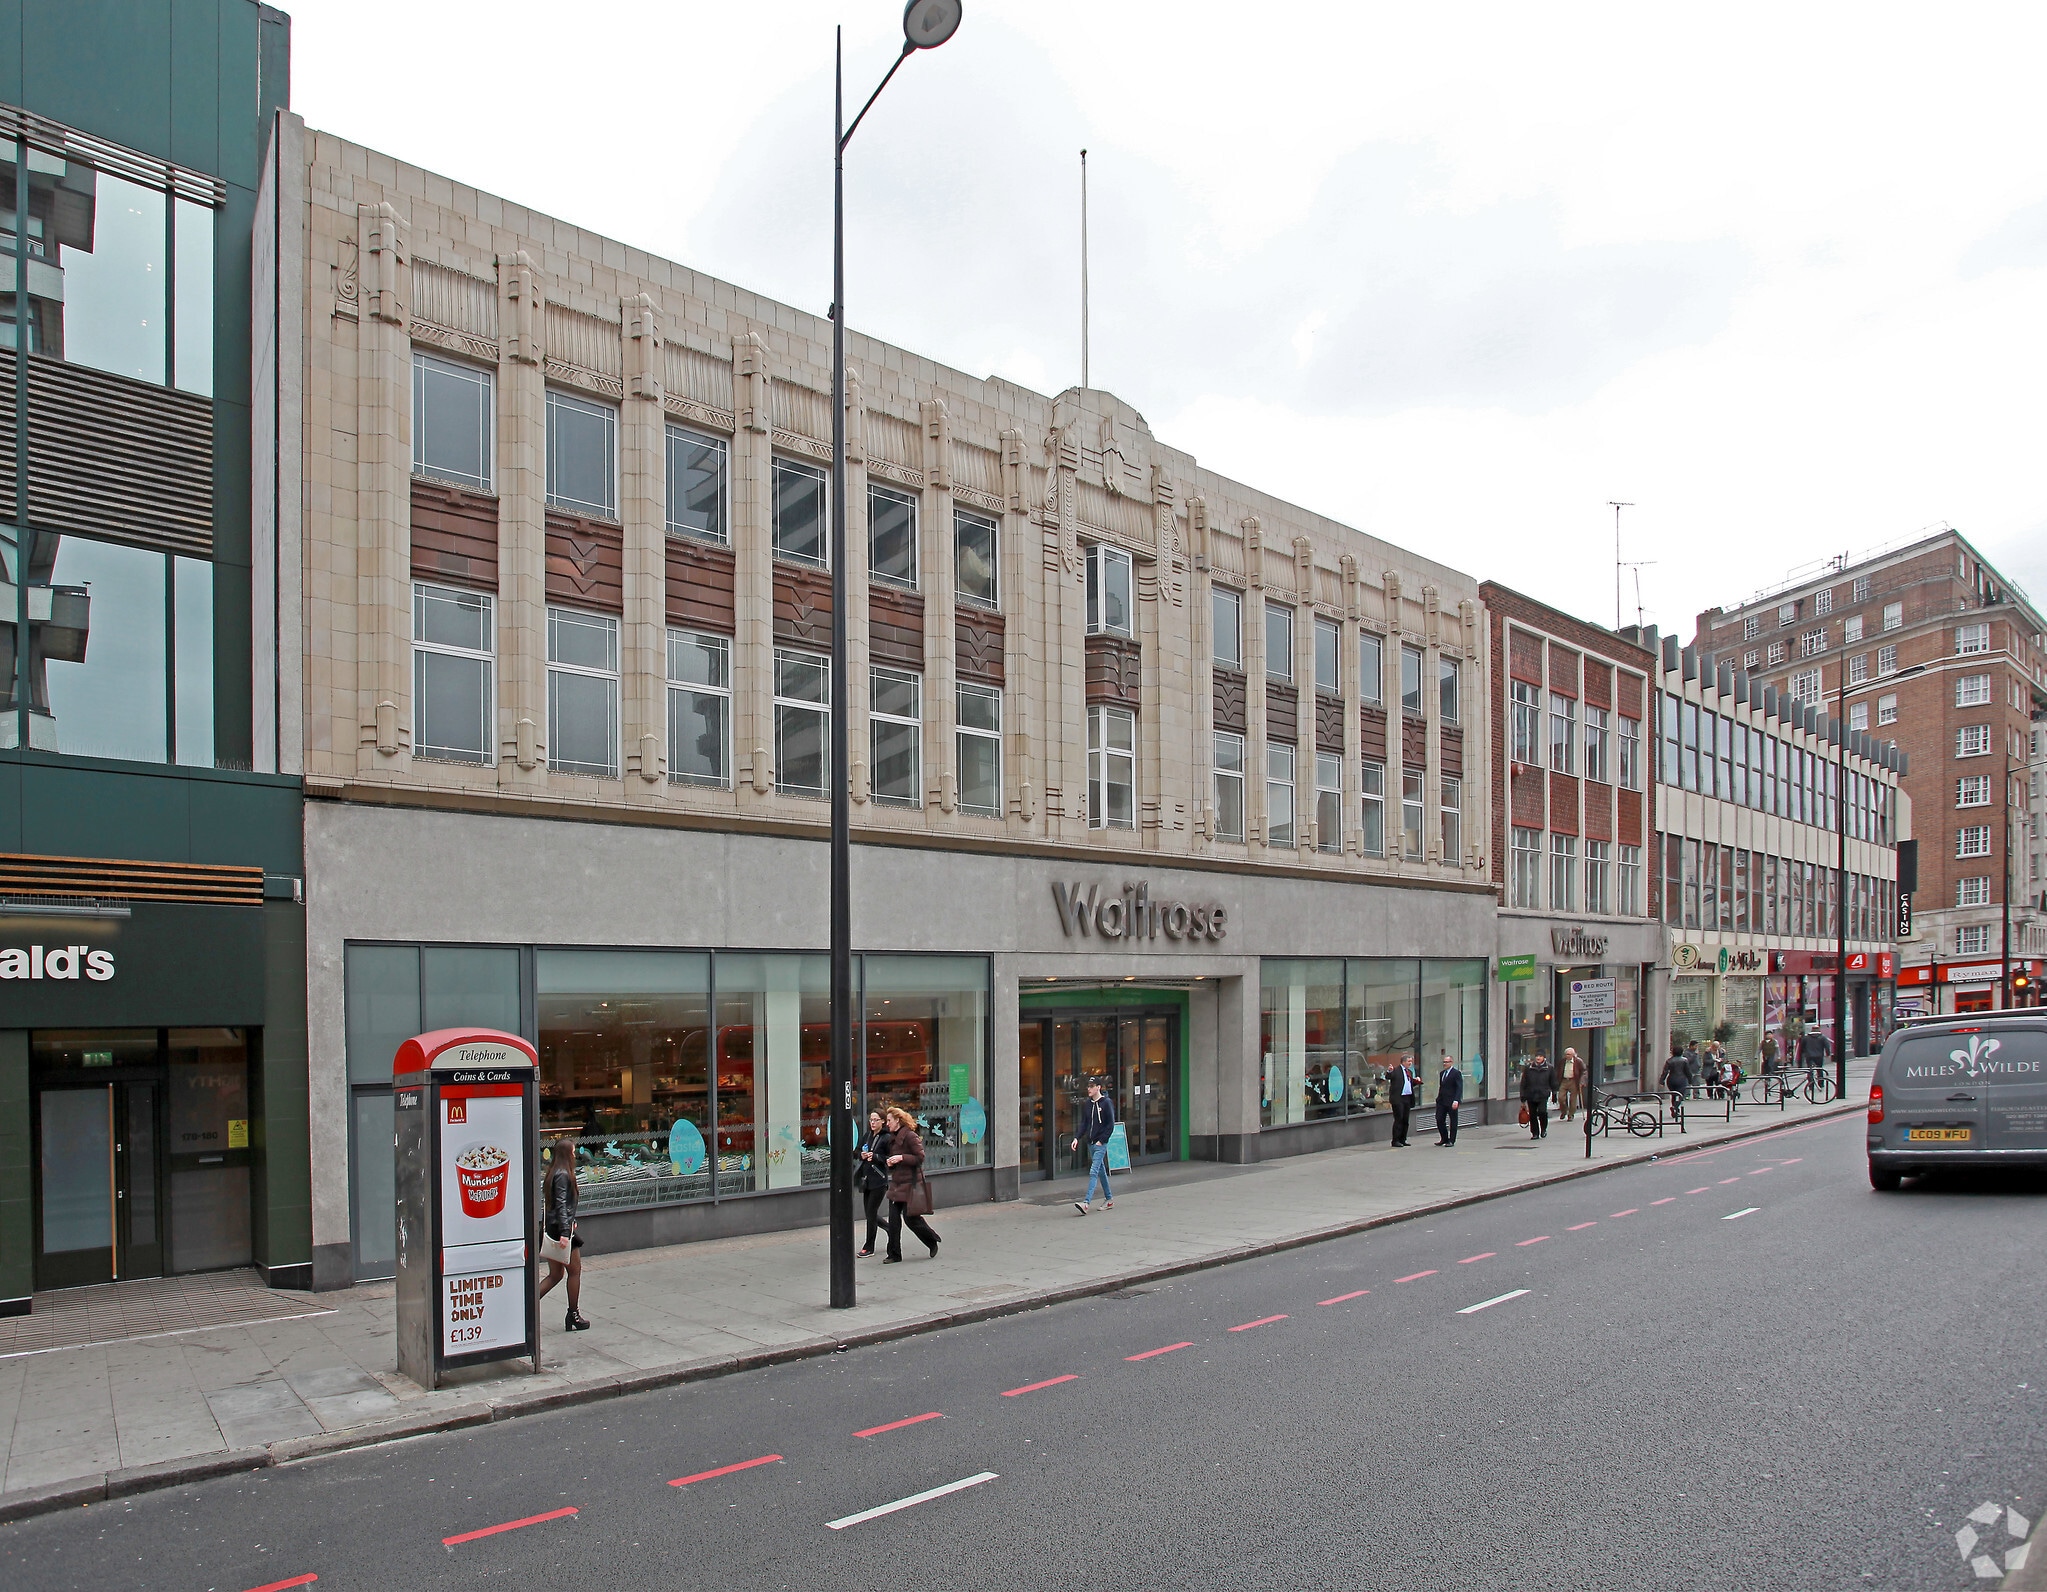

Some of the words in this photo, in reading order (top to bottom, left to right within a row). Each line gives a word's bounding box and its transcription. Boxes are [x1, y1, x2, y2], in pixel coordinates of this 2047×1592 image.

[1051, 879, 1229, 941] Waitrose
[1900, 893, 1911, 935] CASINO
[1550, 925, 1609, 956] Waitrose
[1953, 970, 1998, 979] Ryman
[459, 1050, 507, 1063] Telephone
[453, 1071, 477, 1082] Coins
[477, 1071, 486, 1081] &
[487, 1071, 511, 1081] Cards
[1906, 1065, 1955, 1078] MILES
[1979, 1061, 2040, 1074] WILDE
[1910, 1130, 1941, 1139] LC09
[1944, 1130, 1968, 1139] WFU
[462, 1172, 505, 1187] Munchies
[449, 1275, 503, 1294] LIMITED
[450, 1292, 483, 1308] TIME
[450, 1306, 485, 1322] ONLY
[450, 1326, 483, 1343] £1.39
